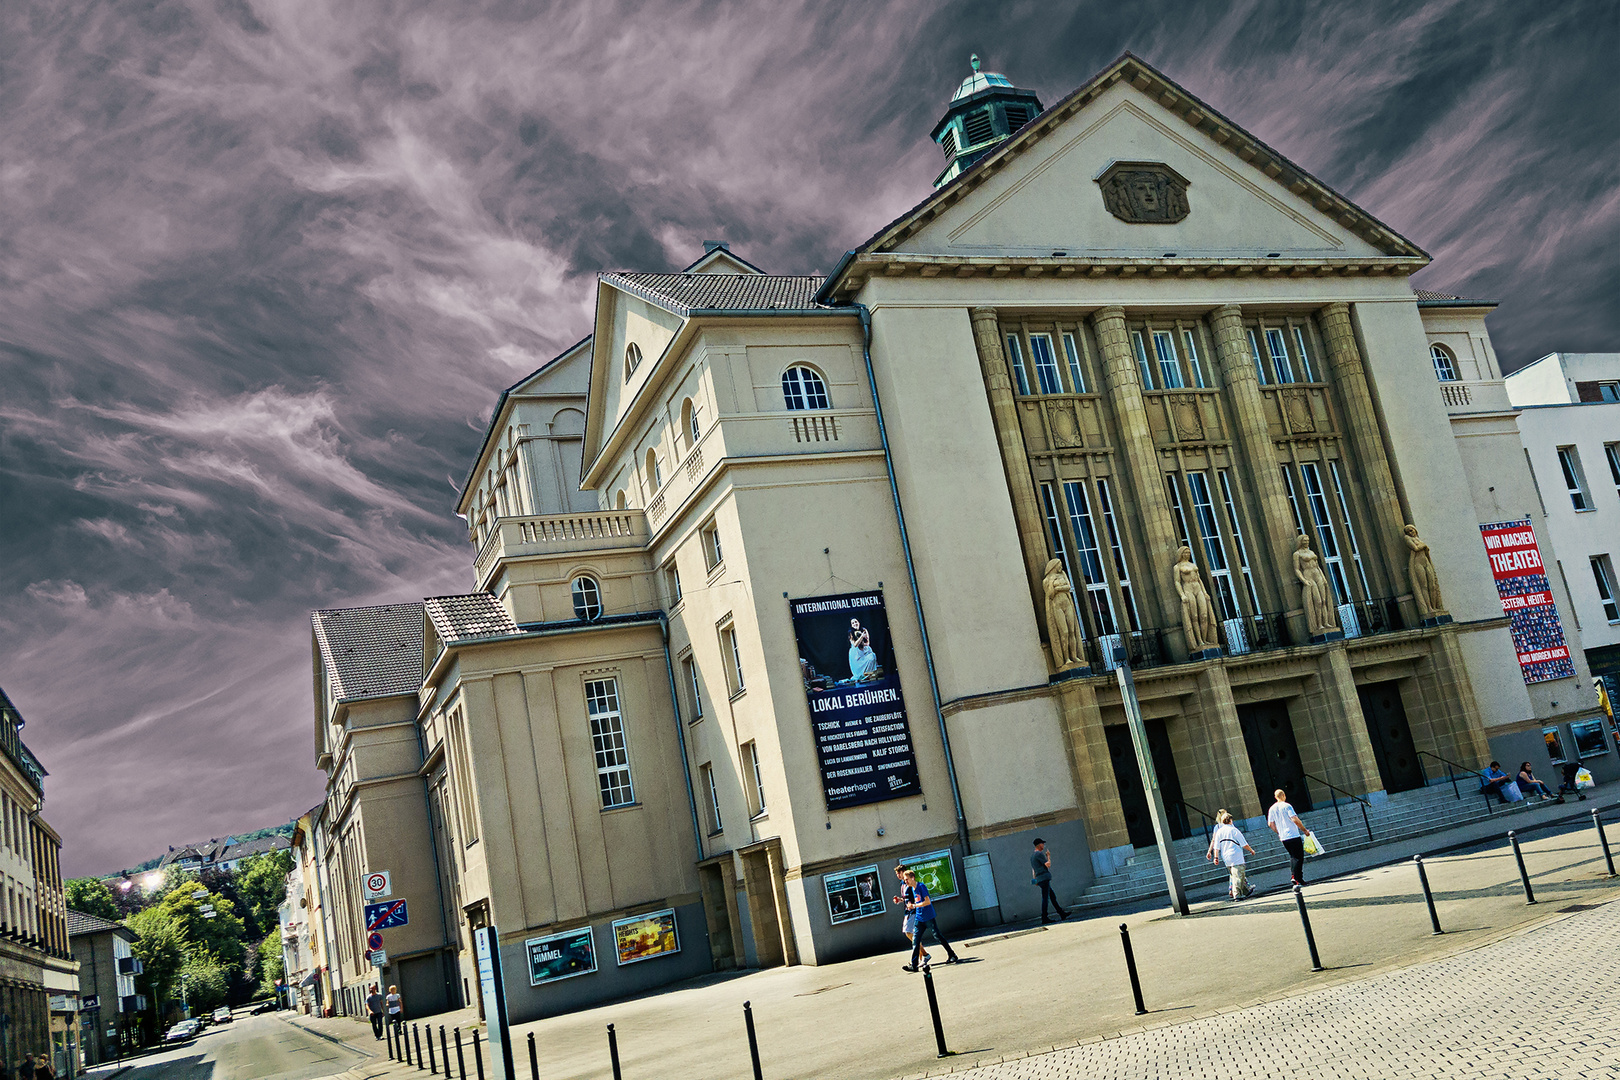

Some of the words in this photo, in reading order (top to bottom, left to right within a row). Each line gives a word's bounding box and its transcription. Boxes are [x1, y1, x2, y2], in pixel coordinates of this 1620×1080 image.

[1485, 535, 1502, 549] WIR
[1501, 532, 1535, 547] MACHEN
[1490, 550, 1541, 572] THEATER
[796, 600, 851, 614] INTERNATIONAL
[851, 596, 881, 608] DENKEN.
[1526, 594, 1546, 606] HEUTE
[1531, 650, 1552, 661] MORGEN
[1552, 648, 1567, 658] AUCH.
[812, 696, 844, 712] LOKAL
[846, 688, 900, 708] BERÜHREN.
[818, 720, 840, 730] TSCHICK
[872, 722, 904, 734] SATISFACTION
[833, 740, 864, 752] BABELSBERG
[878, 733, 906, 744] HOLLYWOOD
[872, 749, 887, 757] KALIF
[888, 744, 909, 755] STORCH
[837, 765, 873, 777] ROSENKAVALIER
[828, 782, 876, 796] theaterhagen
[371, 878, 382, 888] 30
[618, 928, 638, 937] HEIGHTS
[533, 949, 562, 964] HIMMEL
